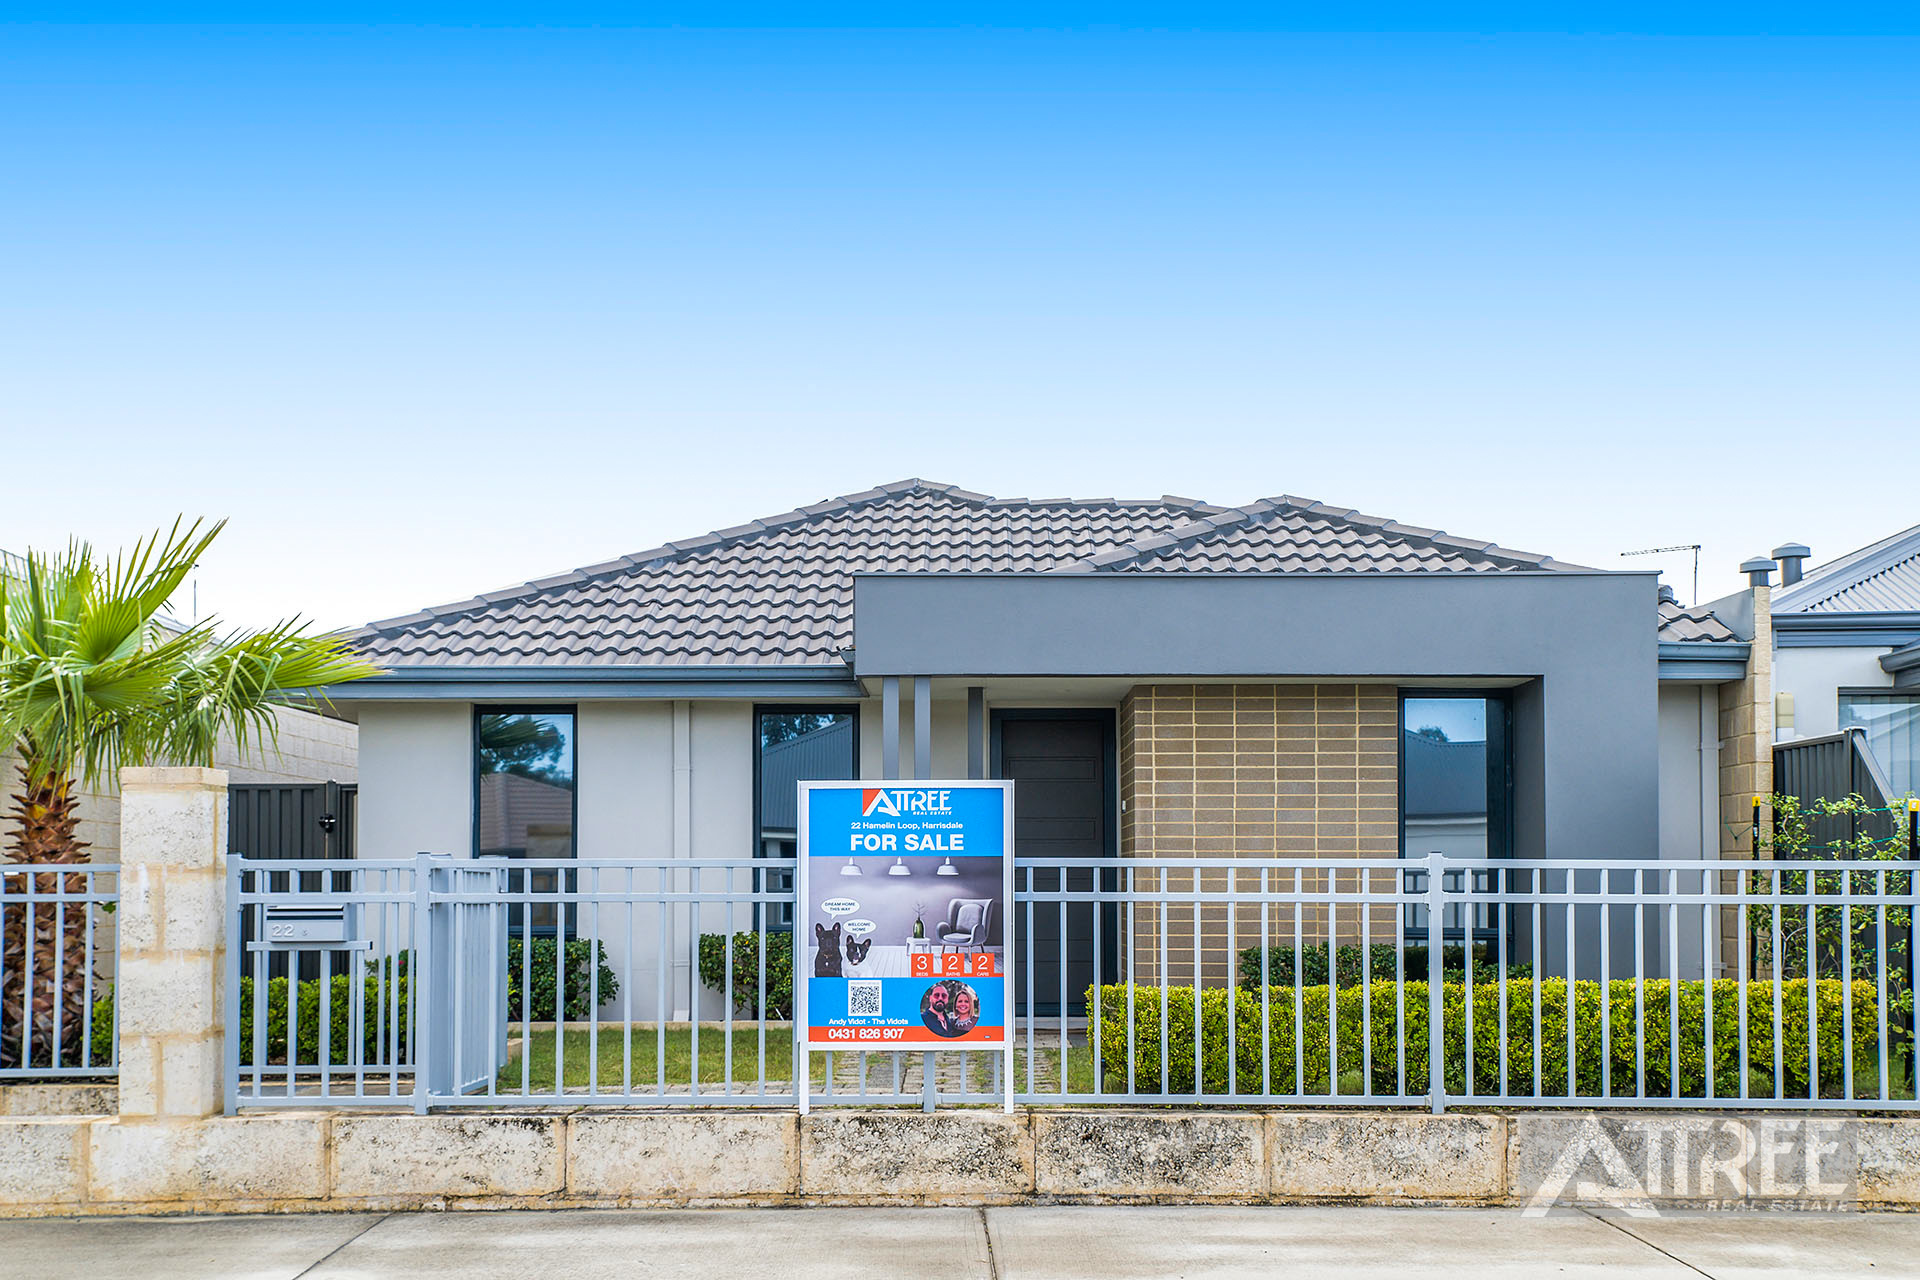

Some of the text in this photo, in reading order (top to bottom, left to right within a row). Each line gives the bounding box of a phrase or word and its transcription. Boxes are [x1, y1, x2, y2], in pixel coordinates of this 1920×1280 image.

[862, 788, 952, 816] ATTREE
[898, 822, 920, 830] Loop,
[850, 834, 965, 851] FOR SALE
[272, 924, 294, 937] 22
[917, 956, 928, 970] 3
[948, 956, 958, 970] 2
[978, 956, 988, 970] 2
[829, 1018, 846, 1026] Andy
[829, 1028, 904, 1039] 0431 826 907
